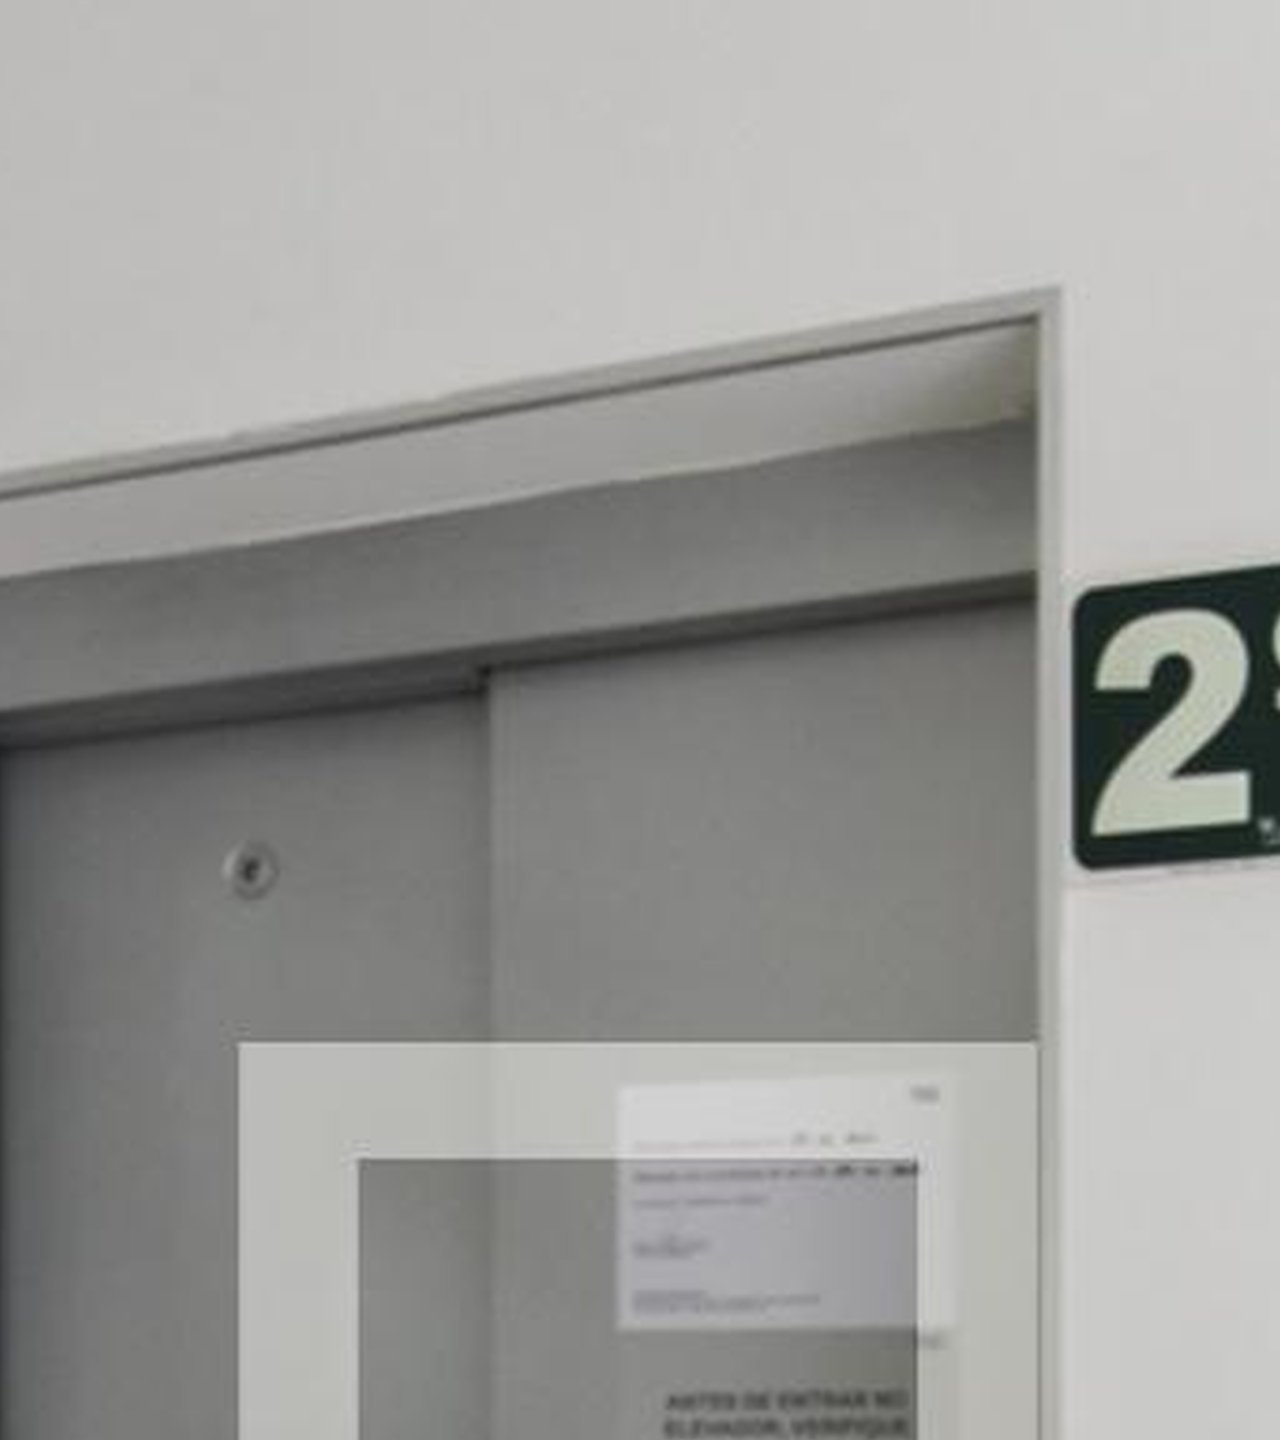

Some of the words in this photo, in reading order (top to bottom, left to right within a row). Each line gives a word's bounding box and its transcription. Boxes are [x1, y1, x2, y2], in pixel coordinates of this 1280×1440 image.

[665, 1390, 736, 1410] ANTES
[744, 1389, 770, 1409] DE
[778, 1388, 866, 1409] ENTRAR
[875, 1388, 909, 1409] NO
[791, 1417, 910, 1439] VERIFIQUE
